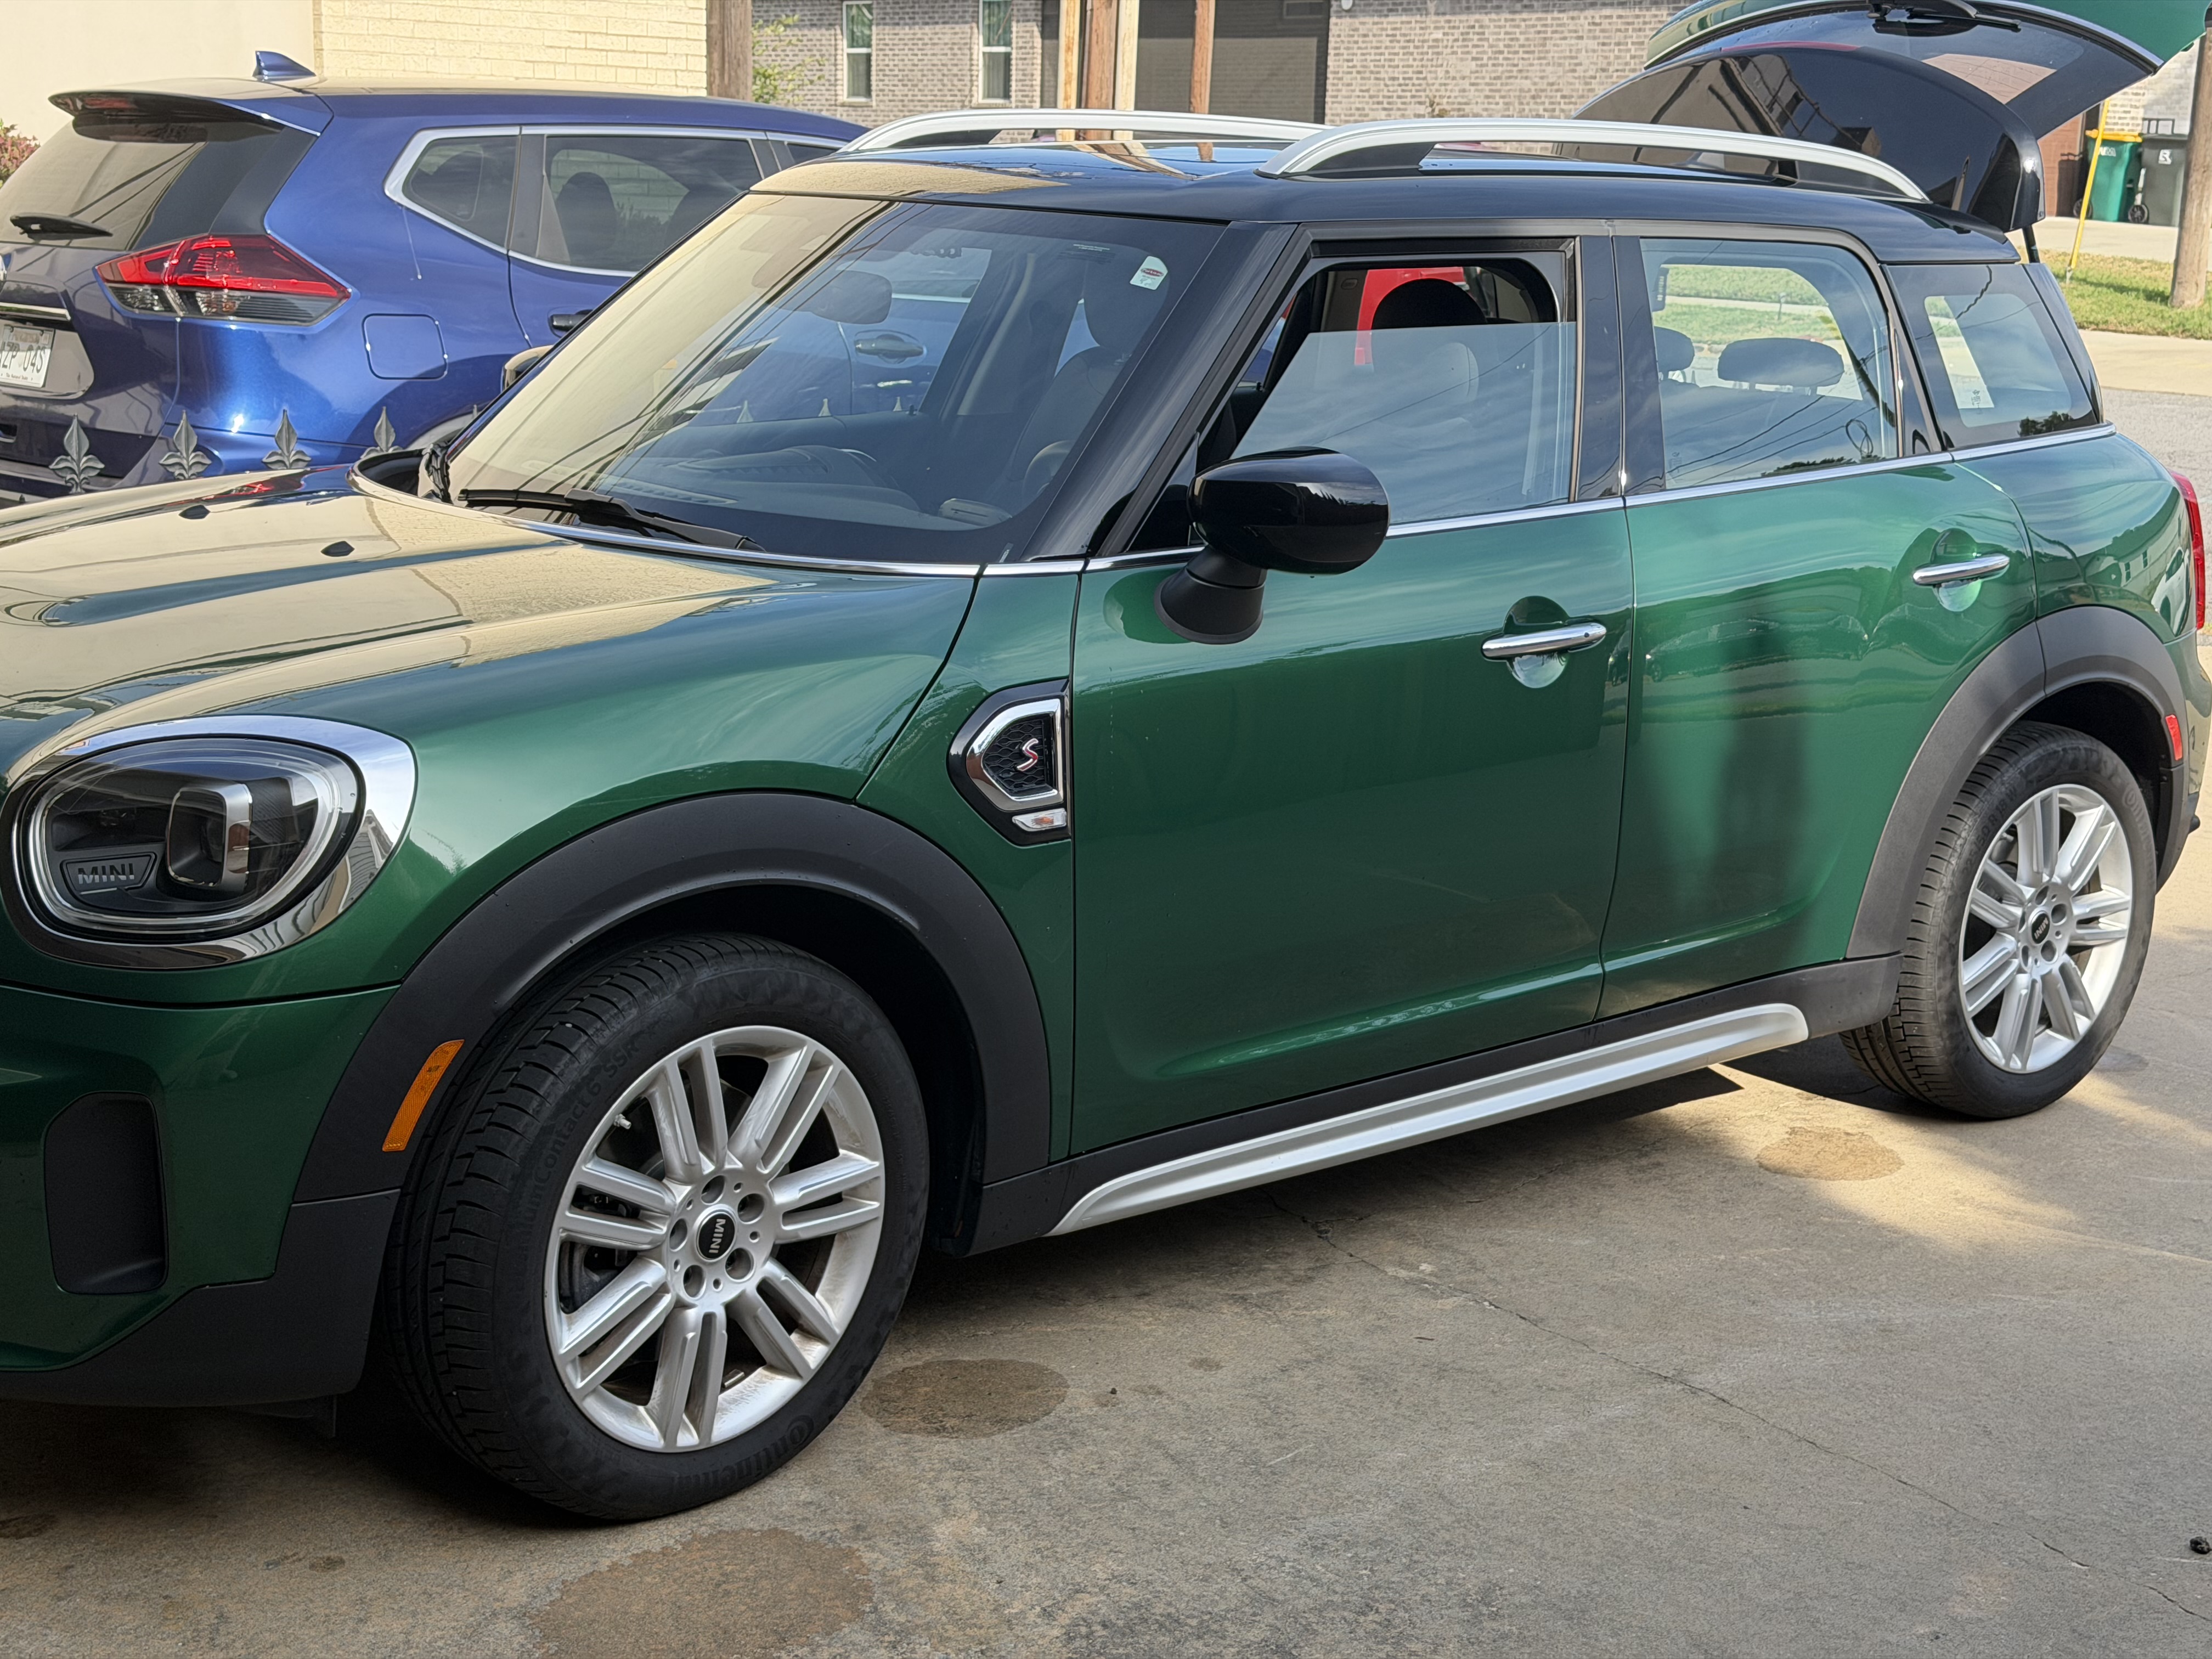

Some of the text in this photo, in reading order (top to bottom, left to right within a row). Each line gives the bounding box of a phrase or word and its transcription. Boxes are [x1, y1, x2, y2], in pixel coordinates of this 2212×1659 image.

[1017, 738, 1039, 771] S
[77, 863, 135, 884] MINI
[2034, 917, 2049, 939] MINI
[602, 1038, 640, 1079] SSR
[709, 1218, 726, 1253] MINI
